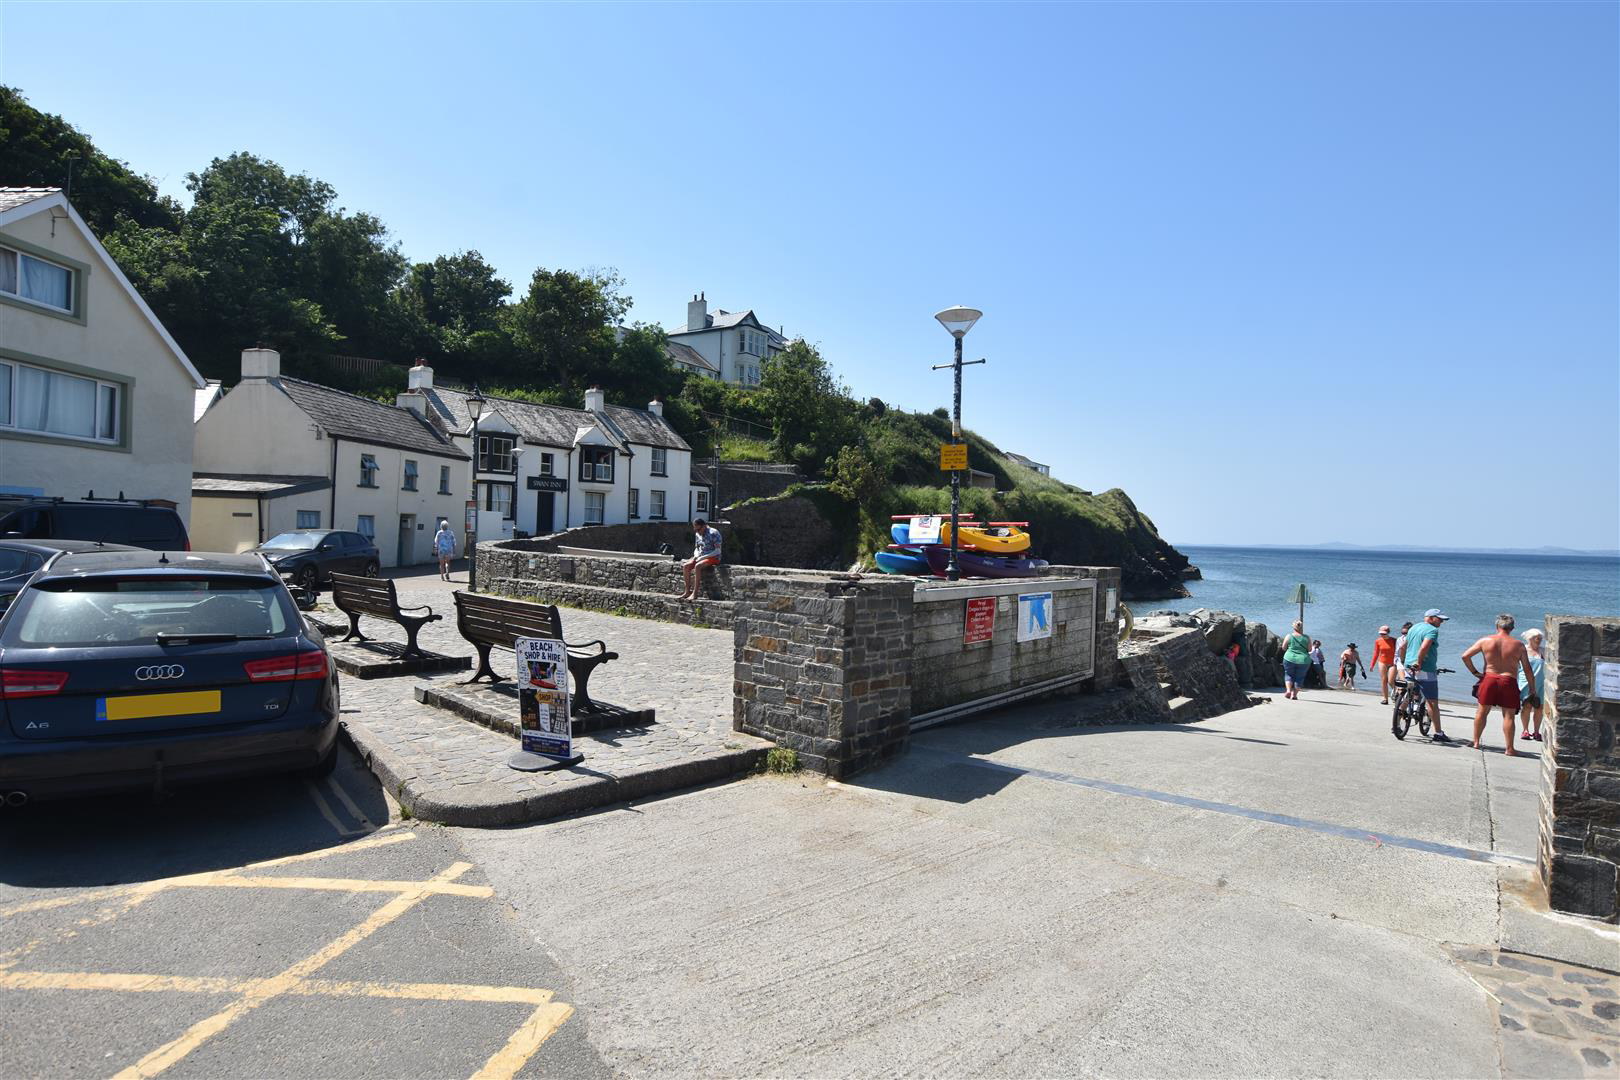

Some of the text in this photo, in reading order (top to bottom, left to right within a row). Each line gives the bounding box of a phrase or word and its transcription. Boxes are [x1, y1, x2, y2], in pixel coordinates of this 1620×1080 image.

[530, 642, 553, 652] BEACH
[525, 651, 561, 662] SHOP & HIRE
[25, 721, 49, 729] A6
